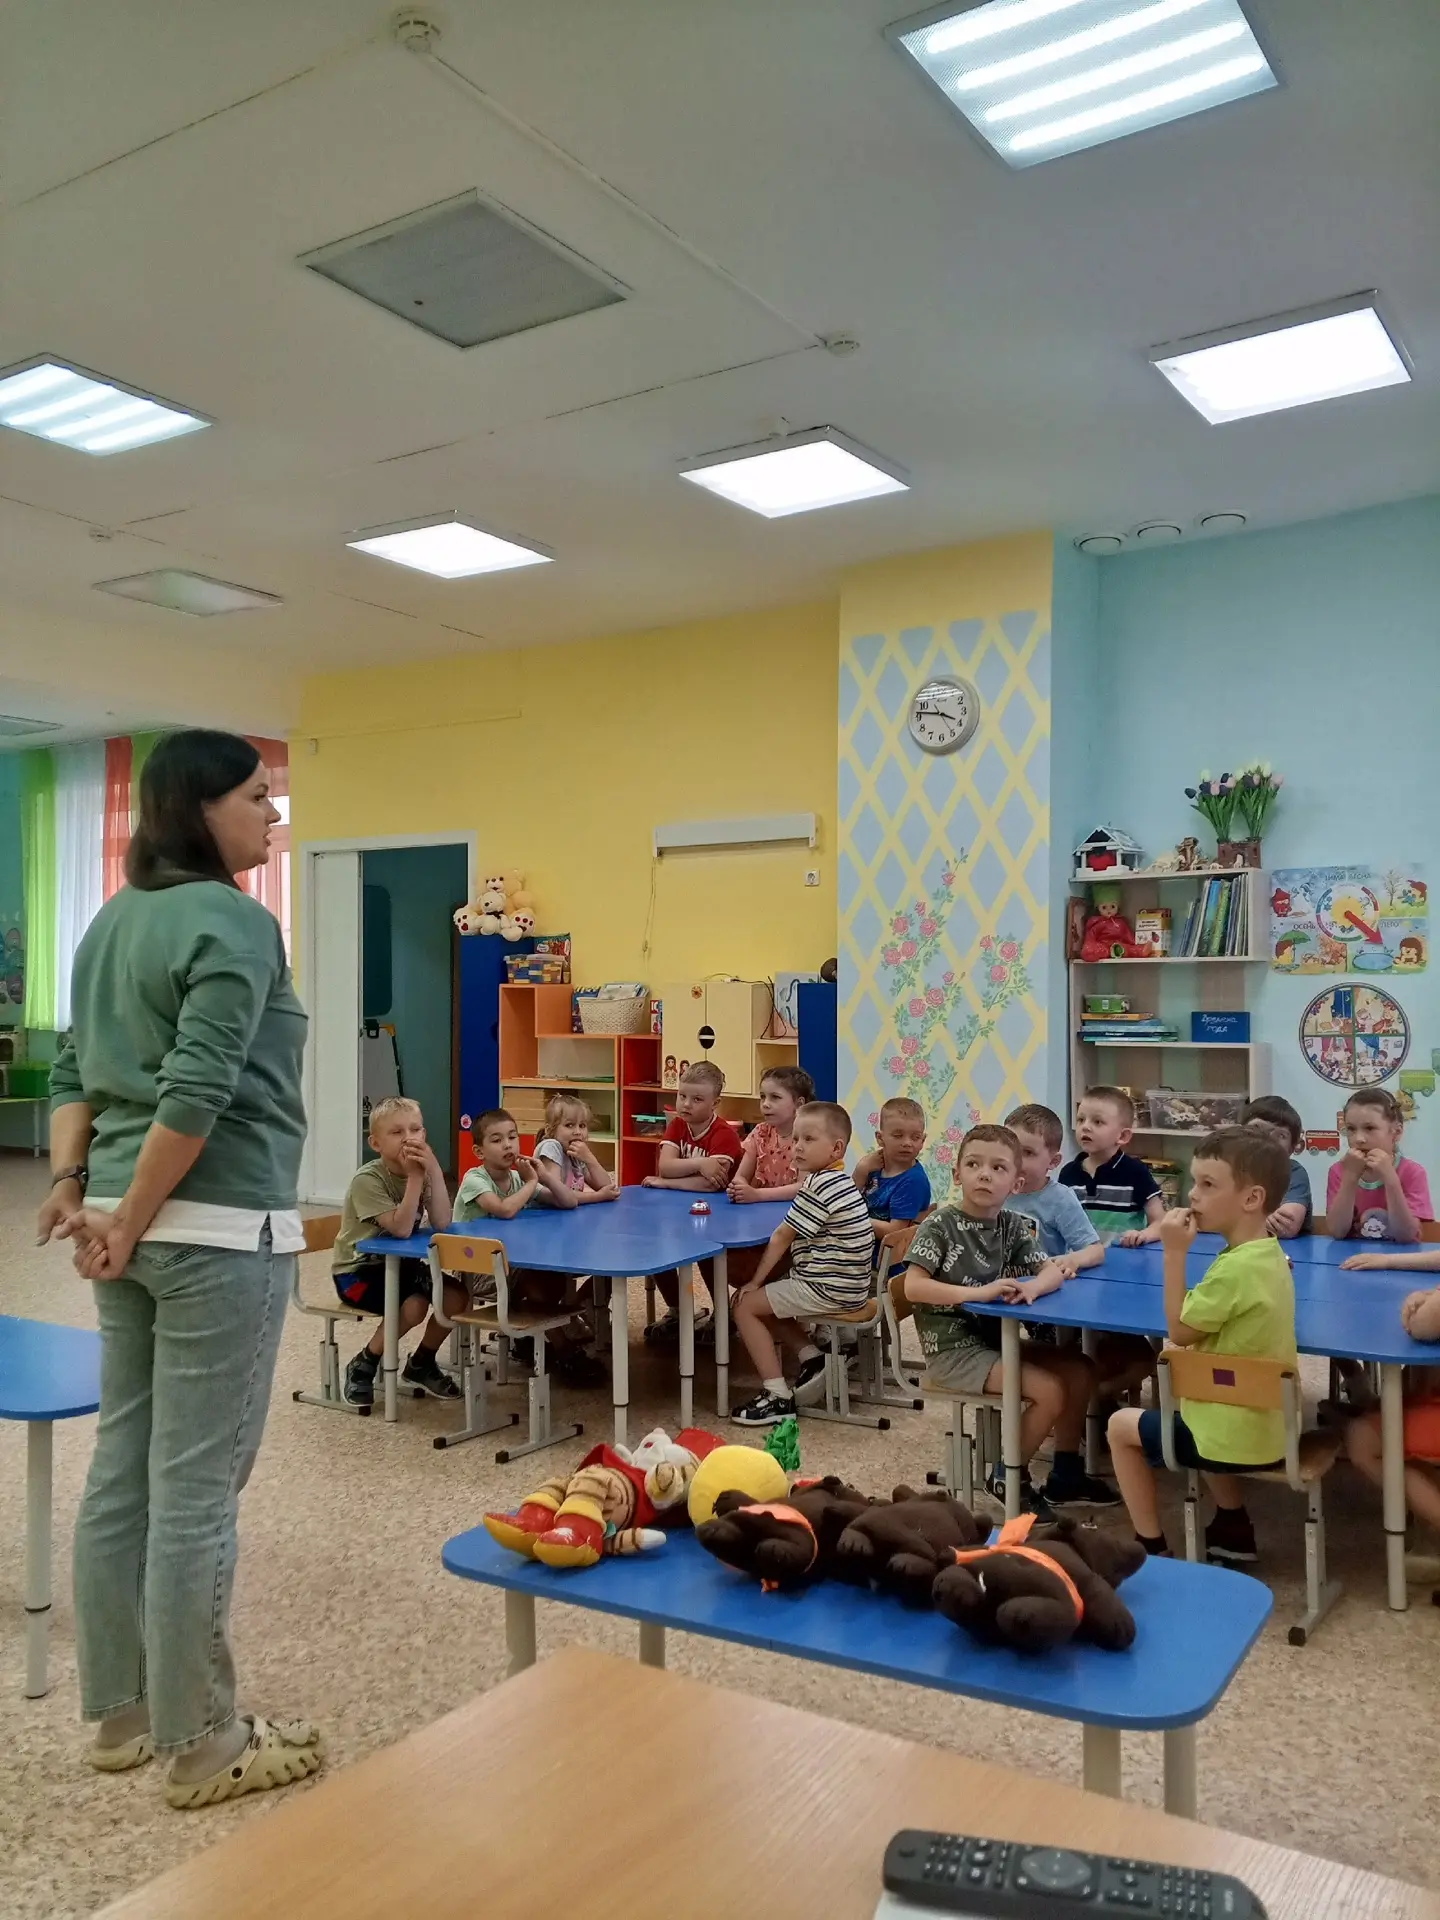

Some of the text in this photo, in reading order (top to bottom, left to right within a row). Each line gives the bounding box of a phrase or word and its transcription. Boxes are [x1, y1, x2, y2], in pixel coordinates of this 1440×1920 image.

[958, 697, 963, 705] 2
[919, 701, 929, 710] 10
[961, 707, 967, 715] 3
[916, 713, 922, 722] 9
[957, 719, 962, 727] 4
[920, 724, 926, 732] 8
[928, 731, 934, 740] 7
[950, 729, 955, 737] 5
[939, 734, 944, 742] 6
